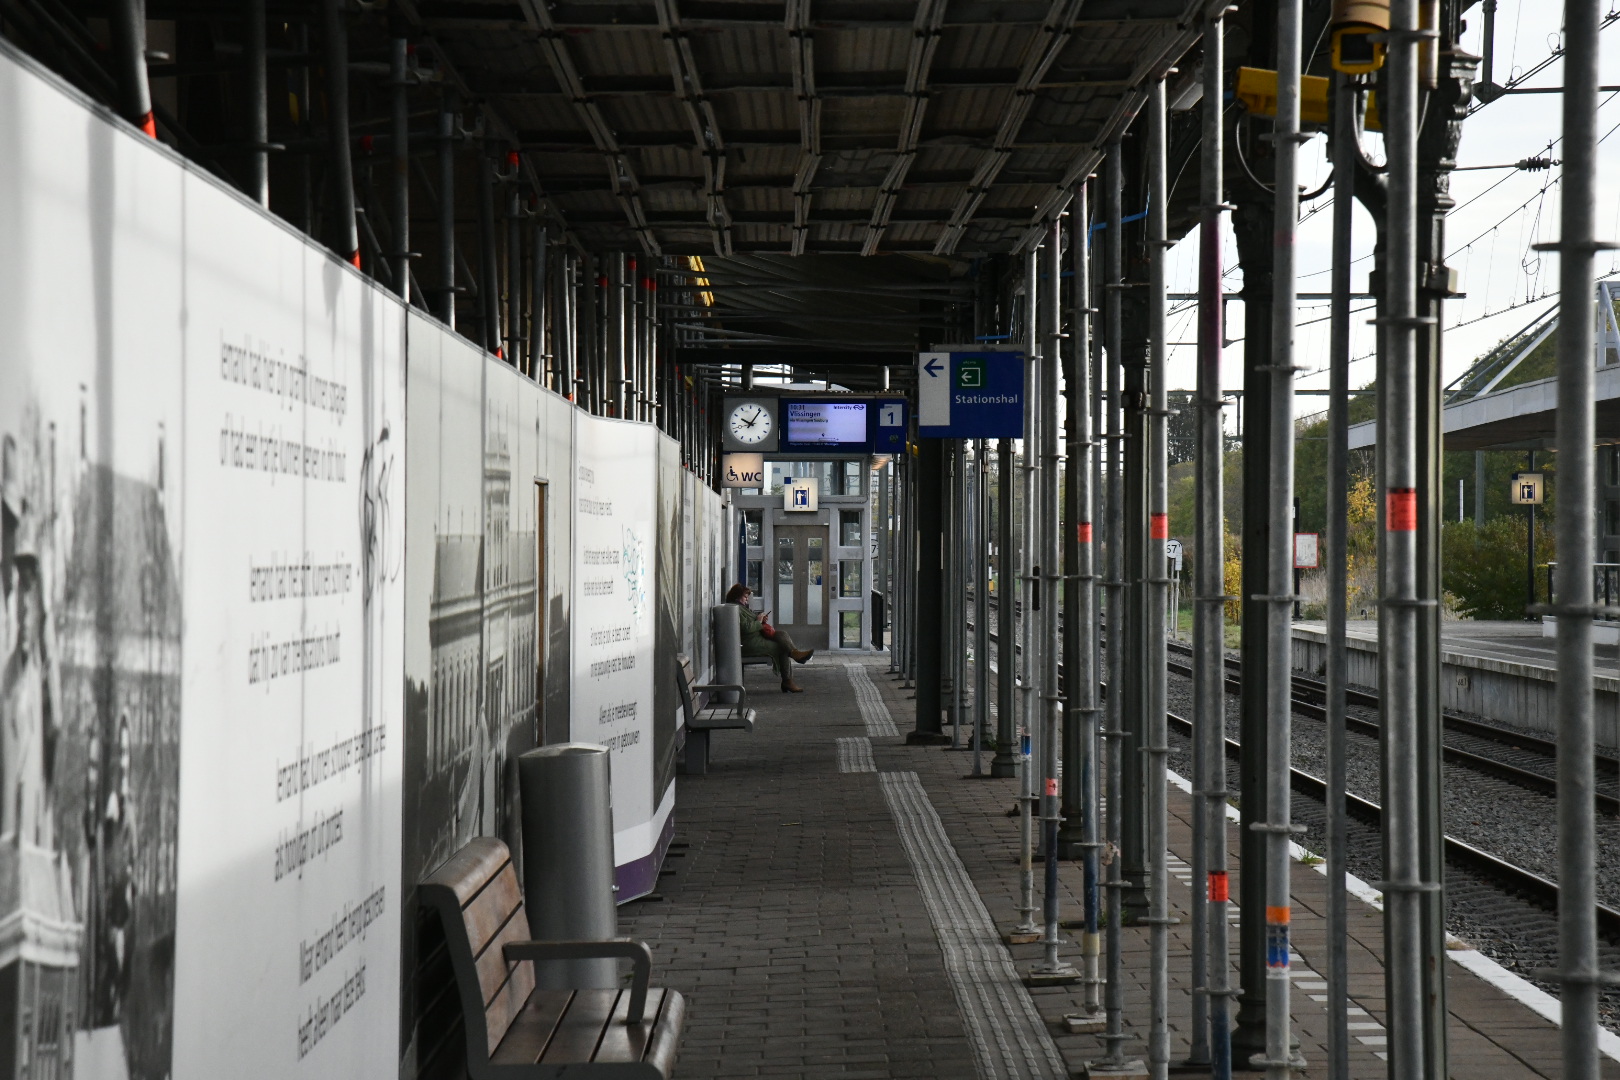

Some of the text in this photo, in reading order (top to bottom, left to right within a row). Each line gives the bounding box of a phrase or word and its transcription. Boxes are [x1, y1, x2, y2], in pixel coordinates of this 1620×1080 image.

[955, 394, 1018, 404] Stationshal
[887, 412, 894, 425] 1
[741, 472, 761, 481] WC
